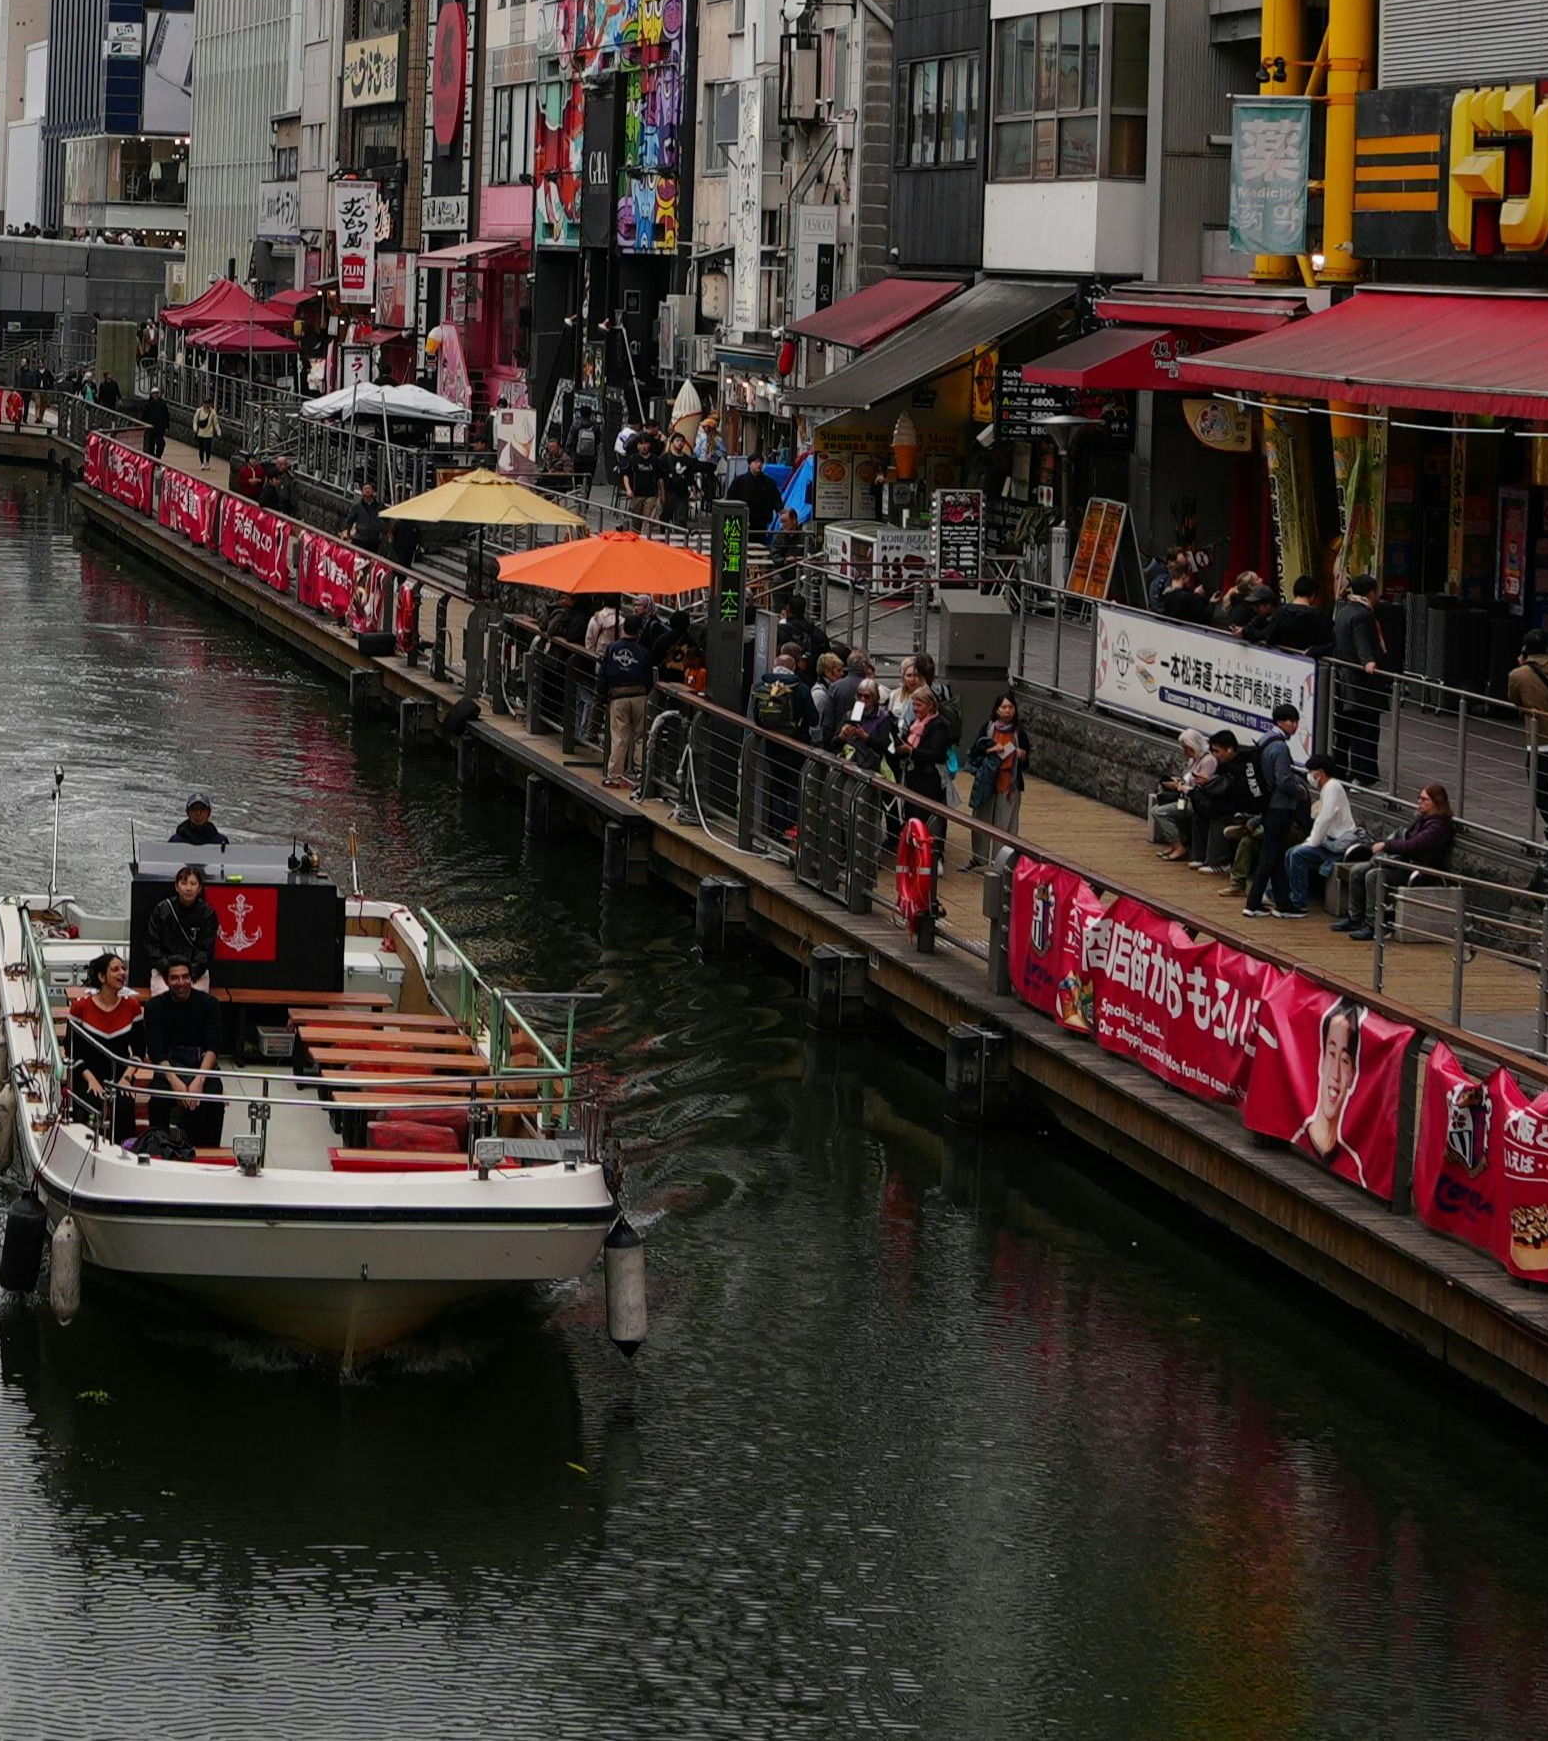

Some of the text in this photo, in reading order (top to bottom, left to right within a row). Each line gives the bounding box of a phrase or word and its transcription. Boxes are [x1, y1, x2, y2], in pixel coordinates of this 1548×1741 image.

[1240, 118, 1302, 183] 薬
[1238, 186, 1301, 200] Medicine
[342, 264, 365, 277] ZUN
[1031, 398, 1056, 407] 4800
[819, 430, 864, 443] Stamina
[722, 515, 742, 573] 松海運
[881, 533, 905, 543] KOBE
[1160, 652, 1213, 693] 一本松海運
